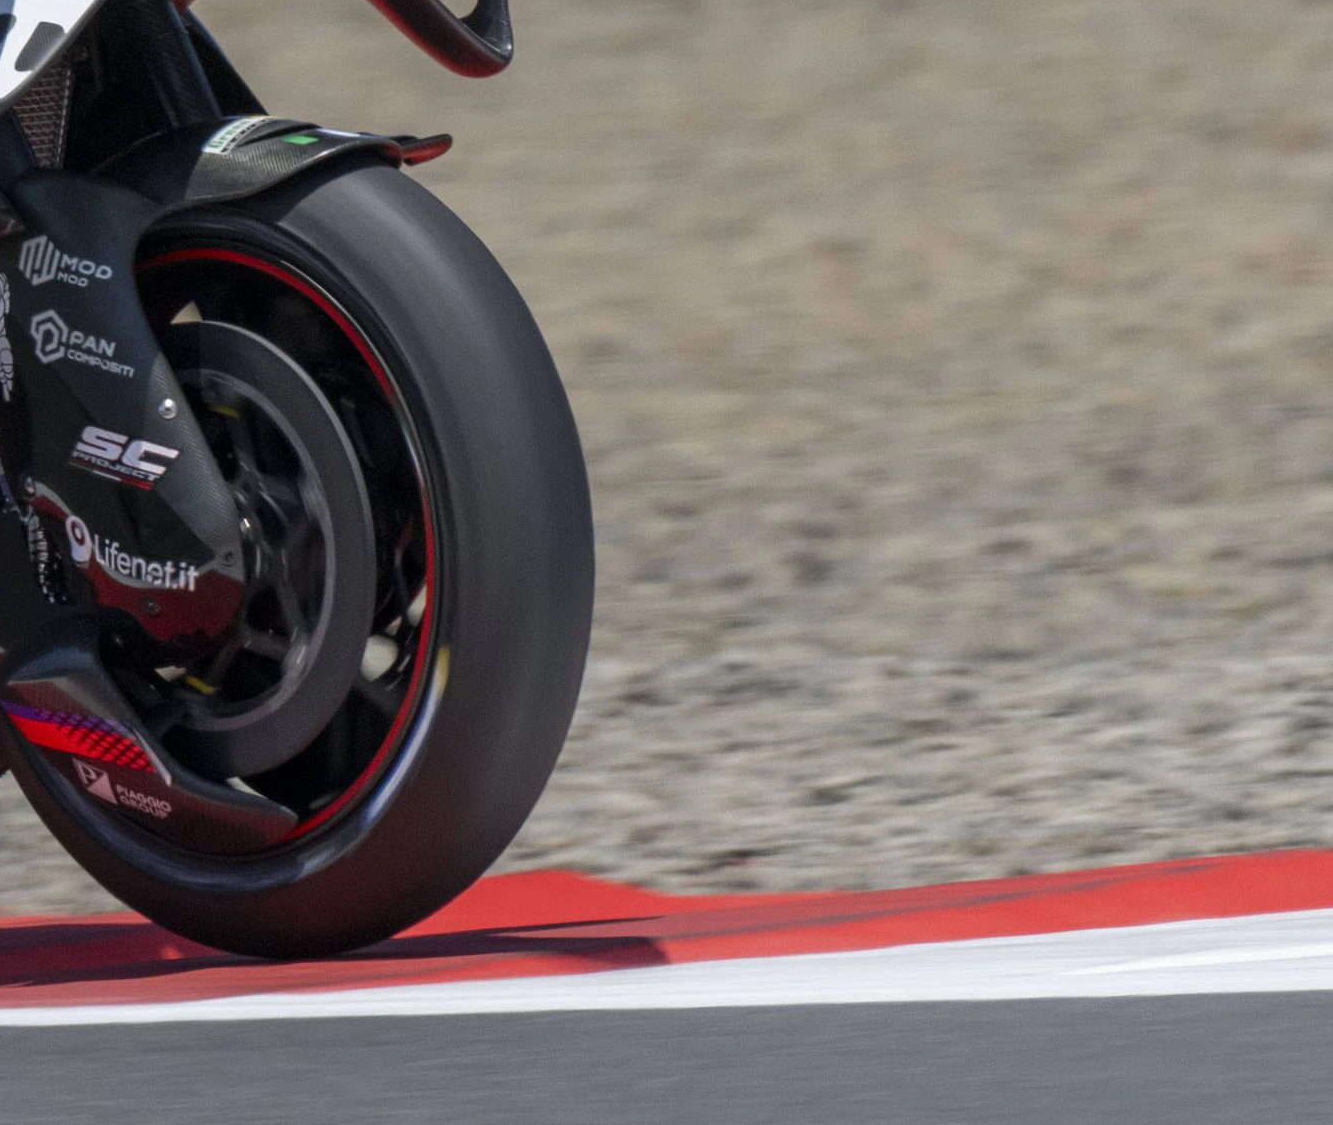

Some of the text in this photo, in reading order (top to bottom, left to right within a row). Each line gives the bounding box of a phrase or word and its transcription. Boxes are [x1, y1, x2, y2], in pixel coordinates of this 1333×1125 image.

[57, 272, 89, 288] MOD
[60, 254, 113, 280] MOD
[69, 330, 116, 357] PAN
[76, 426, 181, 475] SC
[72, 451, 161, 481] PROJECT
[94, 533, 199, 593] Lifenet.it
[116, 784, 172, 813] PIAGGIO
[119, 795, 169, 819] GROUP
